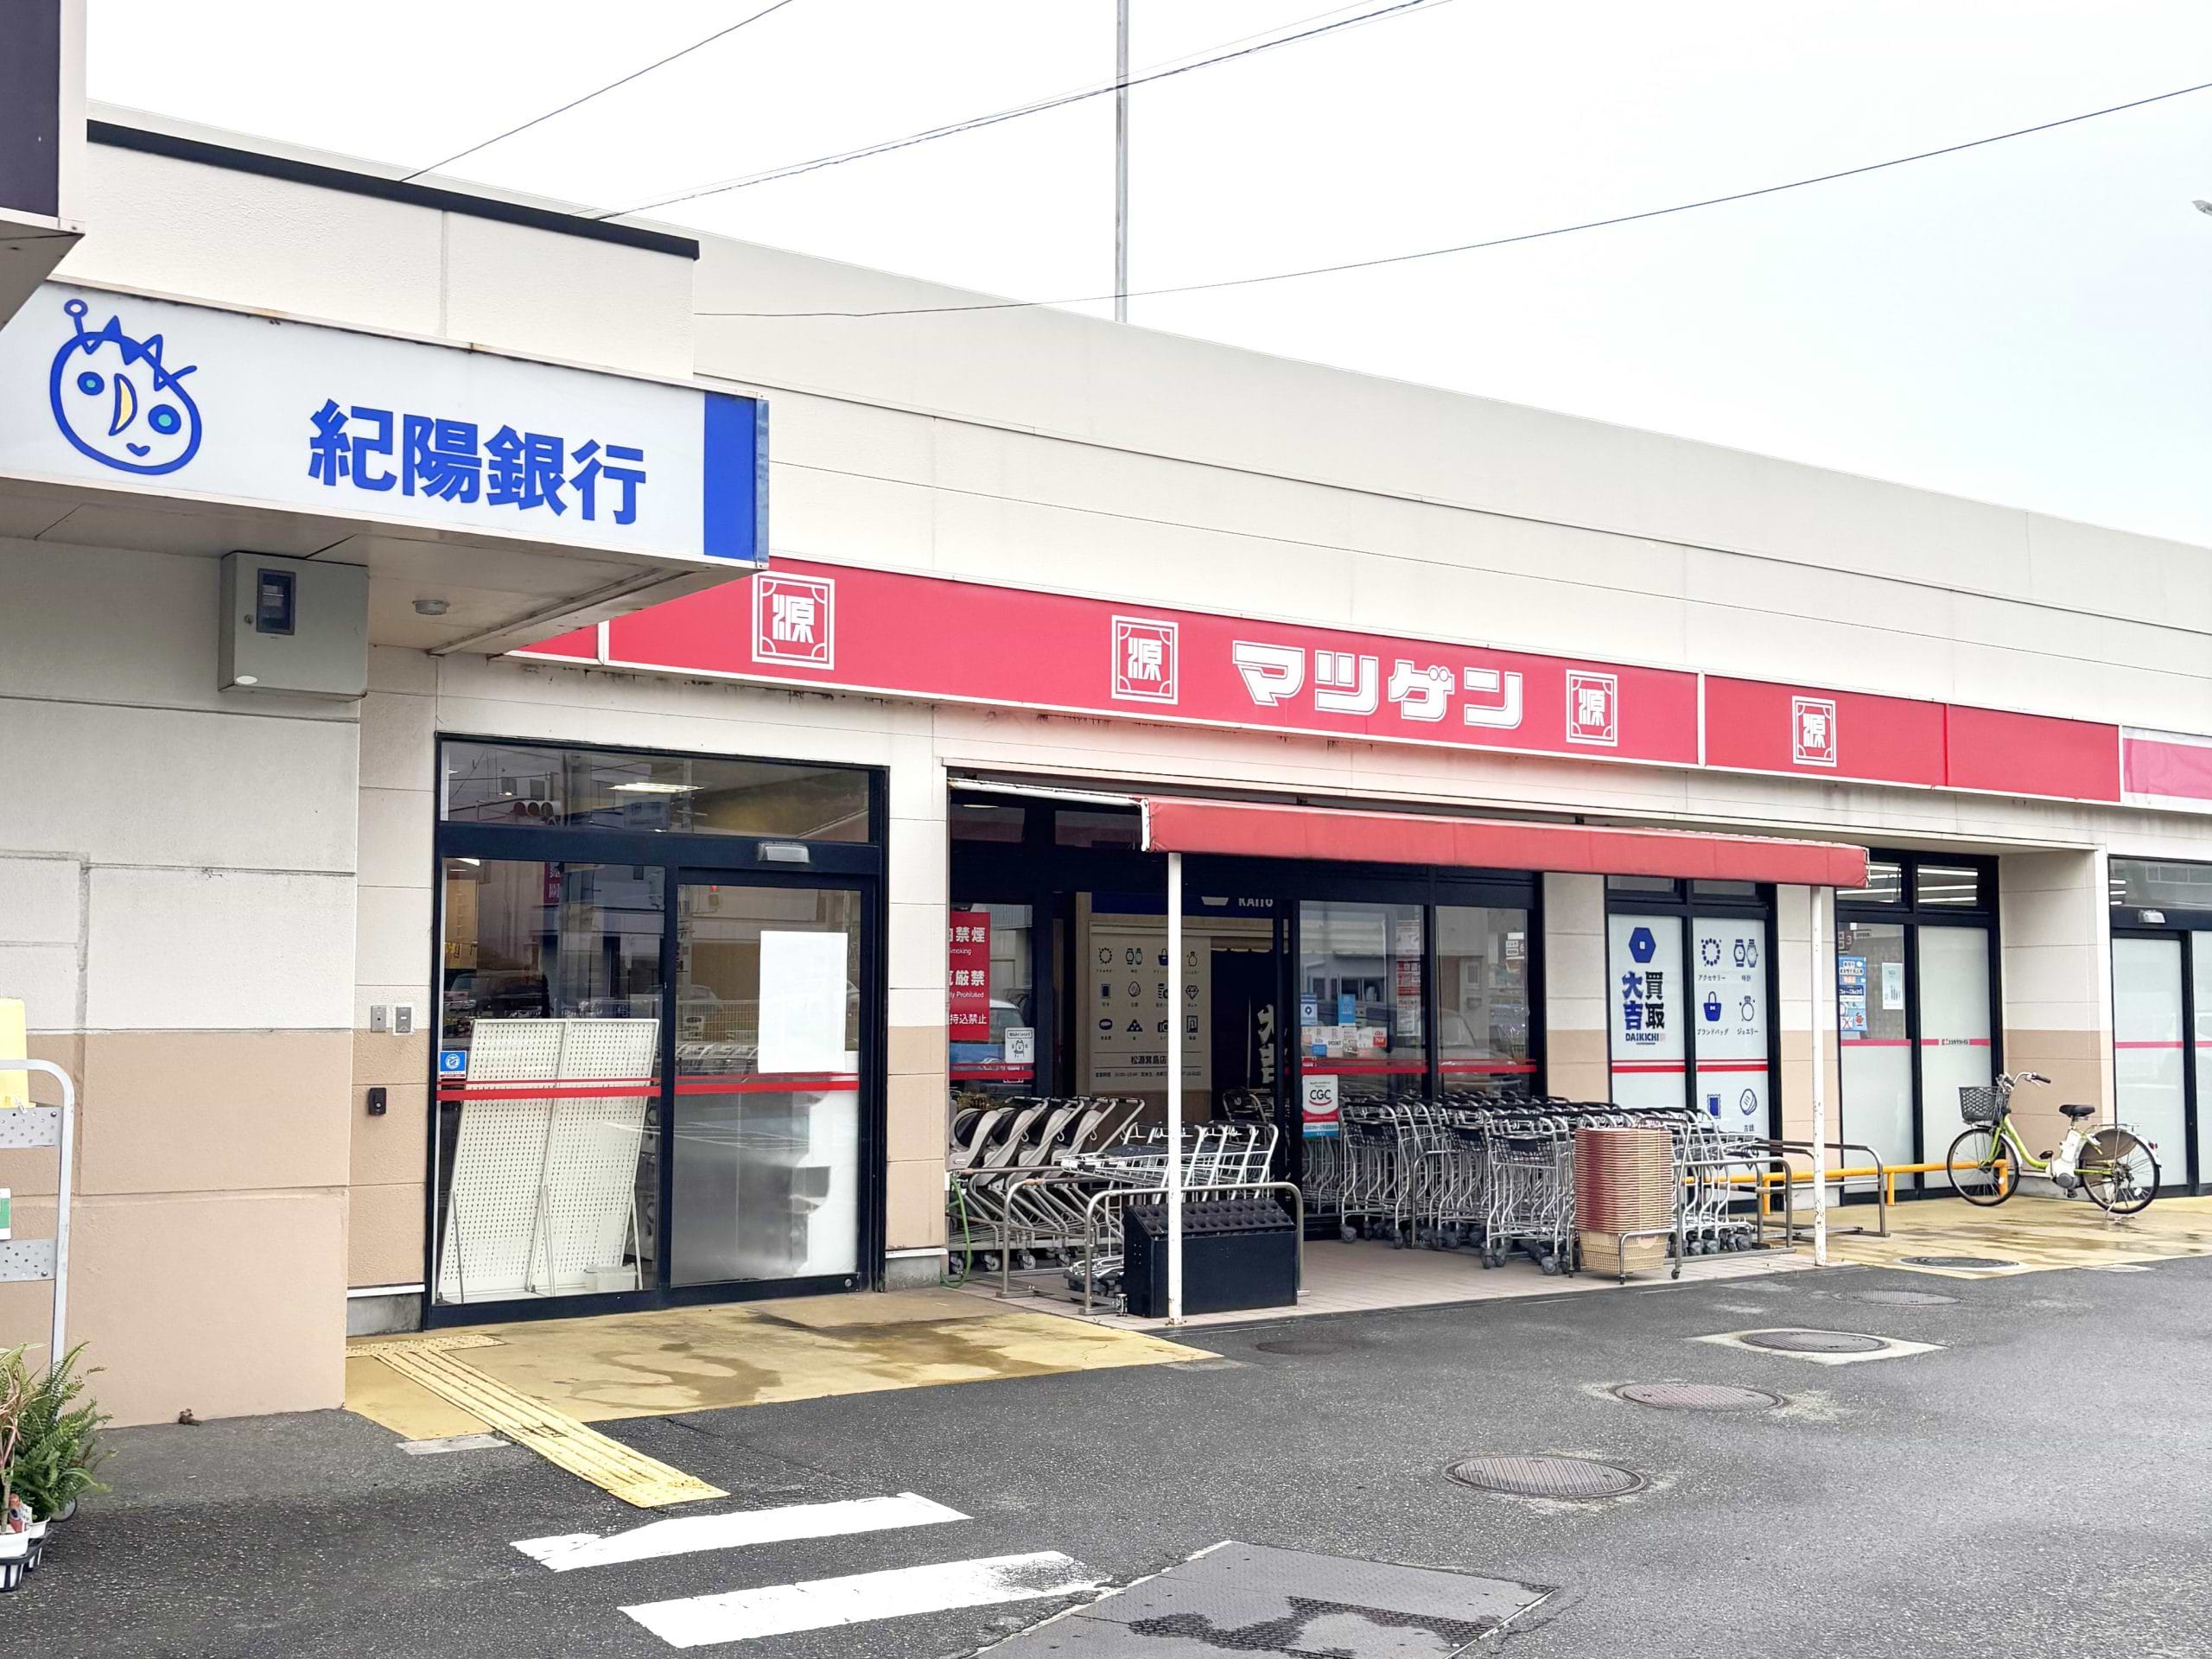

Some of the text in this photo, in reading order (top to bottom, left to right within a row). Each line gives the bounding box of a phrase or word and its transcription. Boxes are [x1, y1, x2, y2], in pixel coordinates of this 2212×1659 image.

[308, 398, 646, 525] 紀陽銀行
[772, 594, 815, 644] 源
[1128, 637, 1163, 681] 源
[1232, 639, 1523, 730] マツゲン
[1578, 688, 1605, 727] 源
[1803, 712, 1827, 748] 源
[1625, 1033, 1659, 1042] DAIKICHI
[1310, 1090, 1332, 1100] CGC
